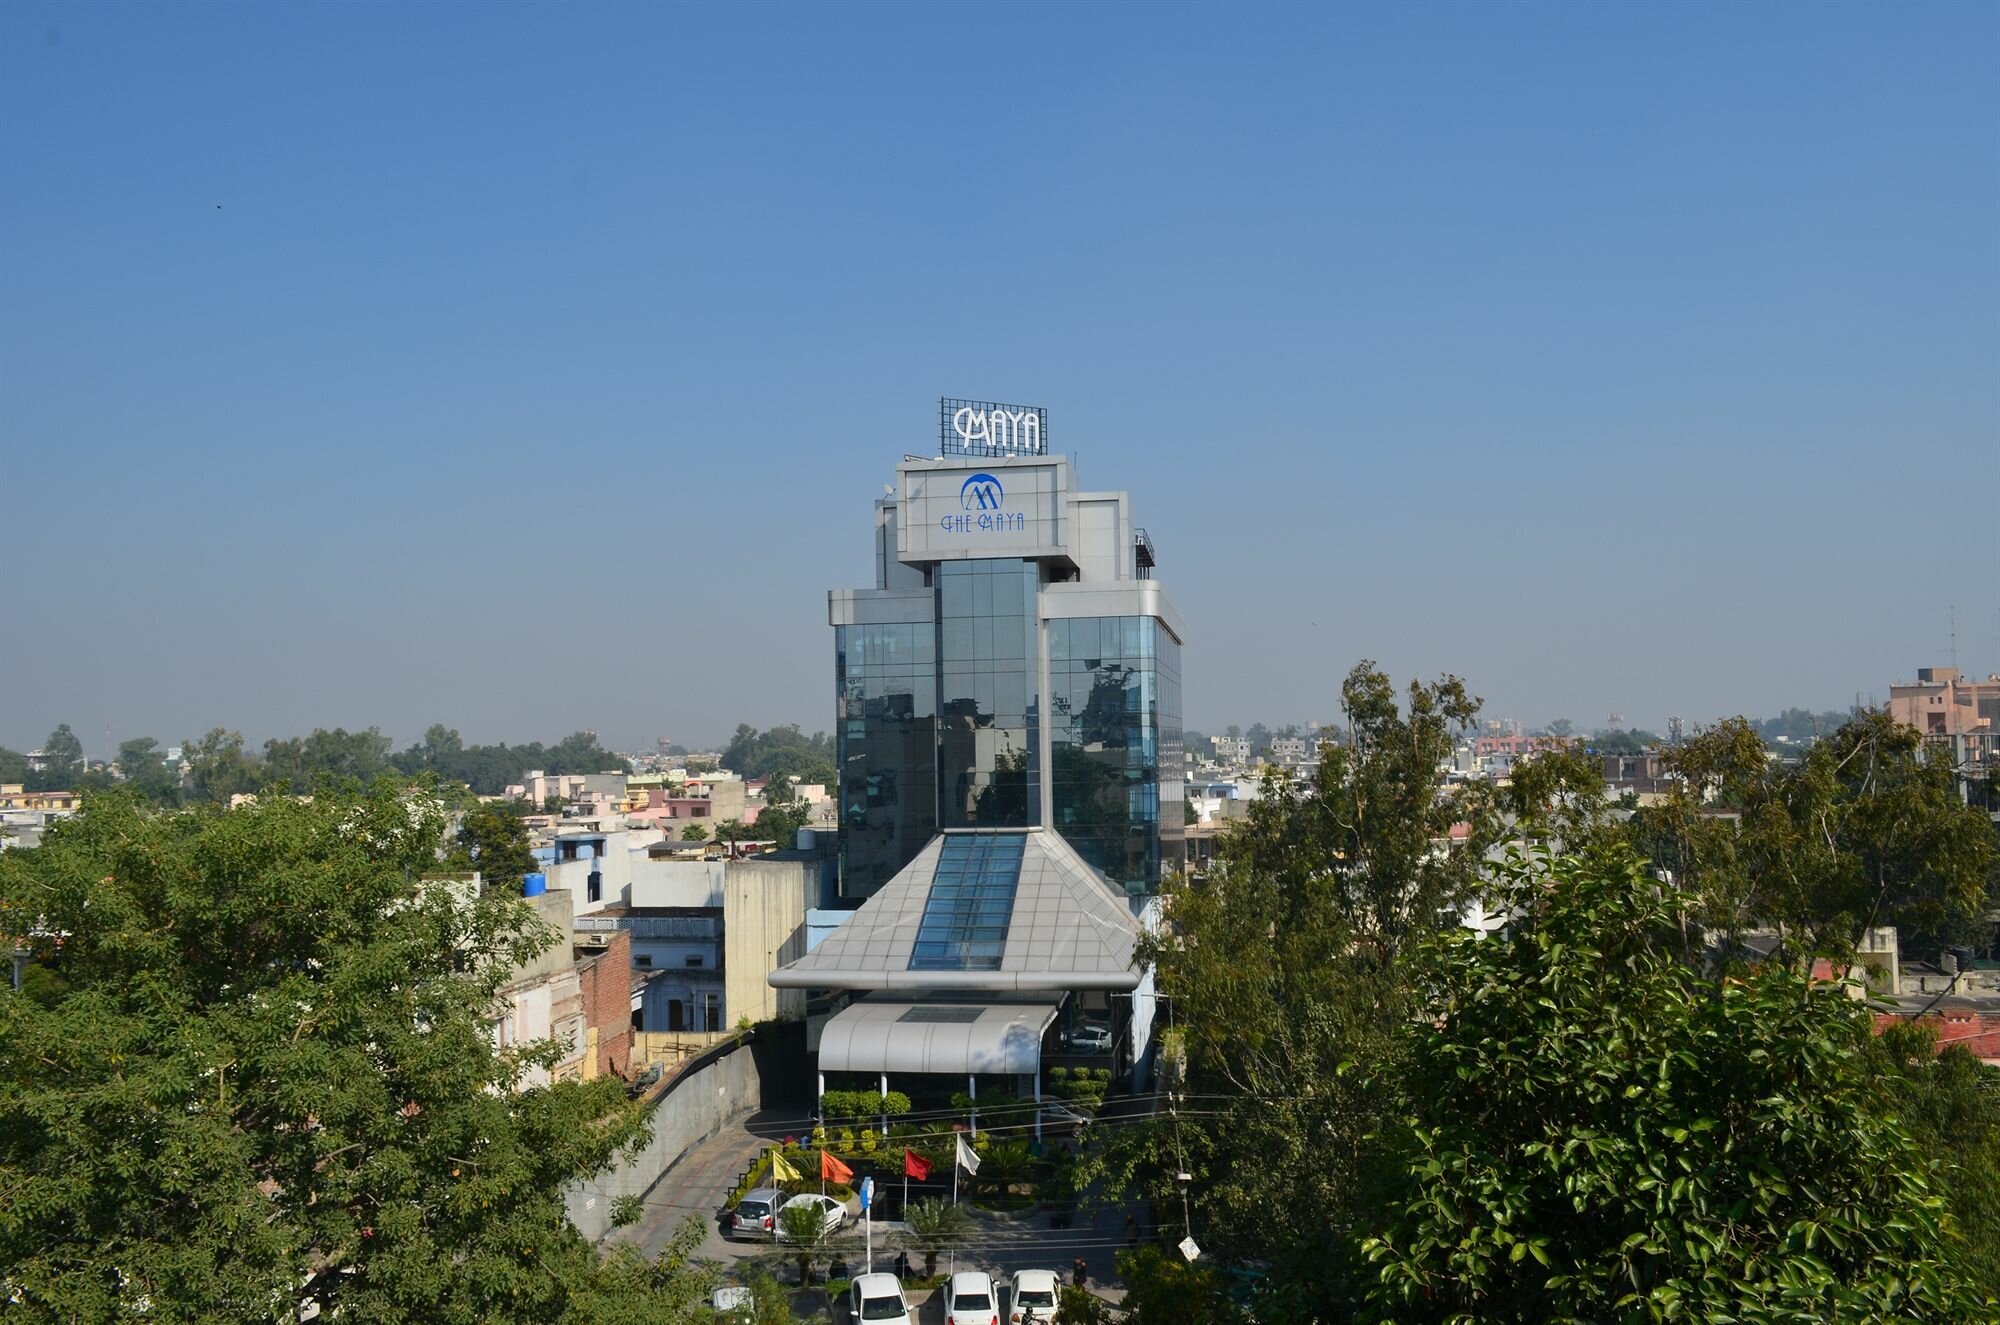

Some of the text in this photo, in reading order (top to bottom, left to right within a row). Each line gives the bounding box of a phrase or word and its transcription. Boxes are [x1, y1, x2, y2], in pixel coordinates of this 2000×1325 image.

[953, 407, 1040, 449] MAYA
[941, 512, 1024, 533] THE MAYA
